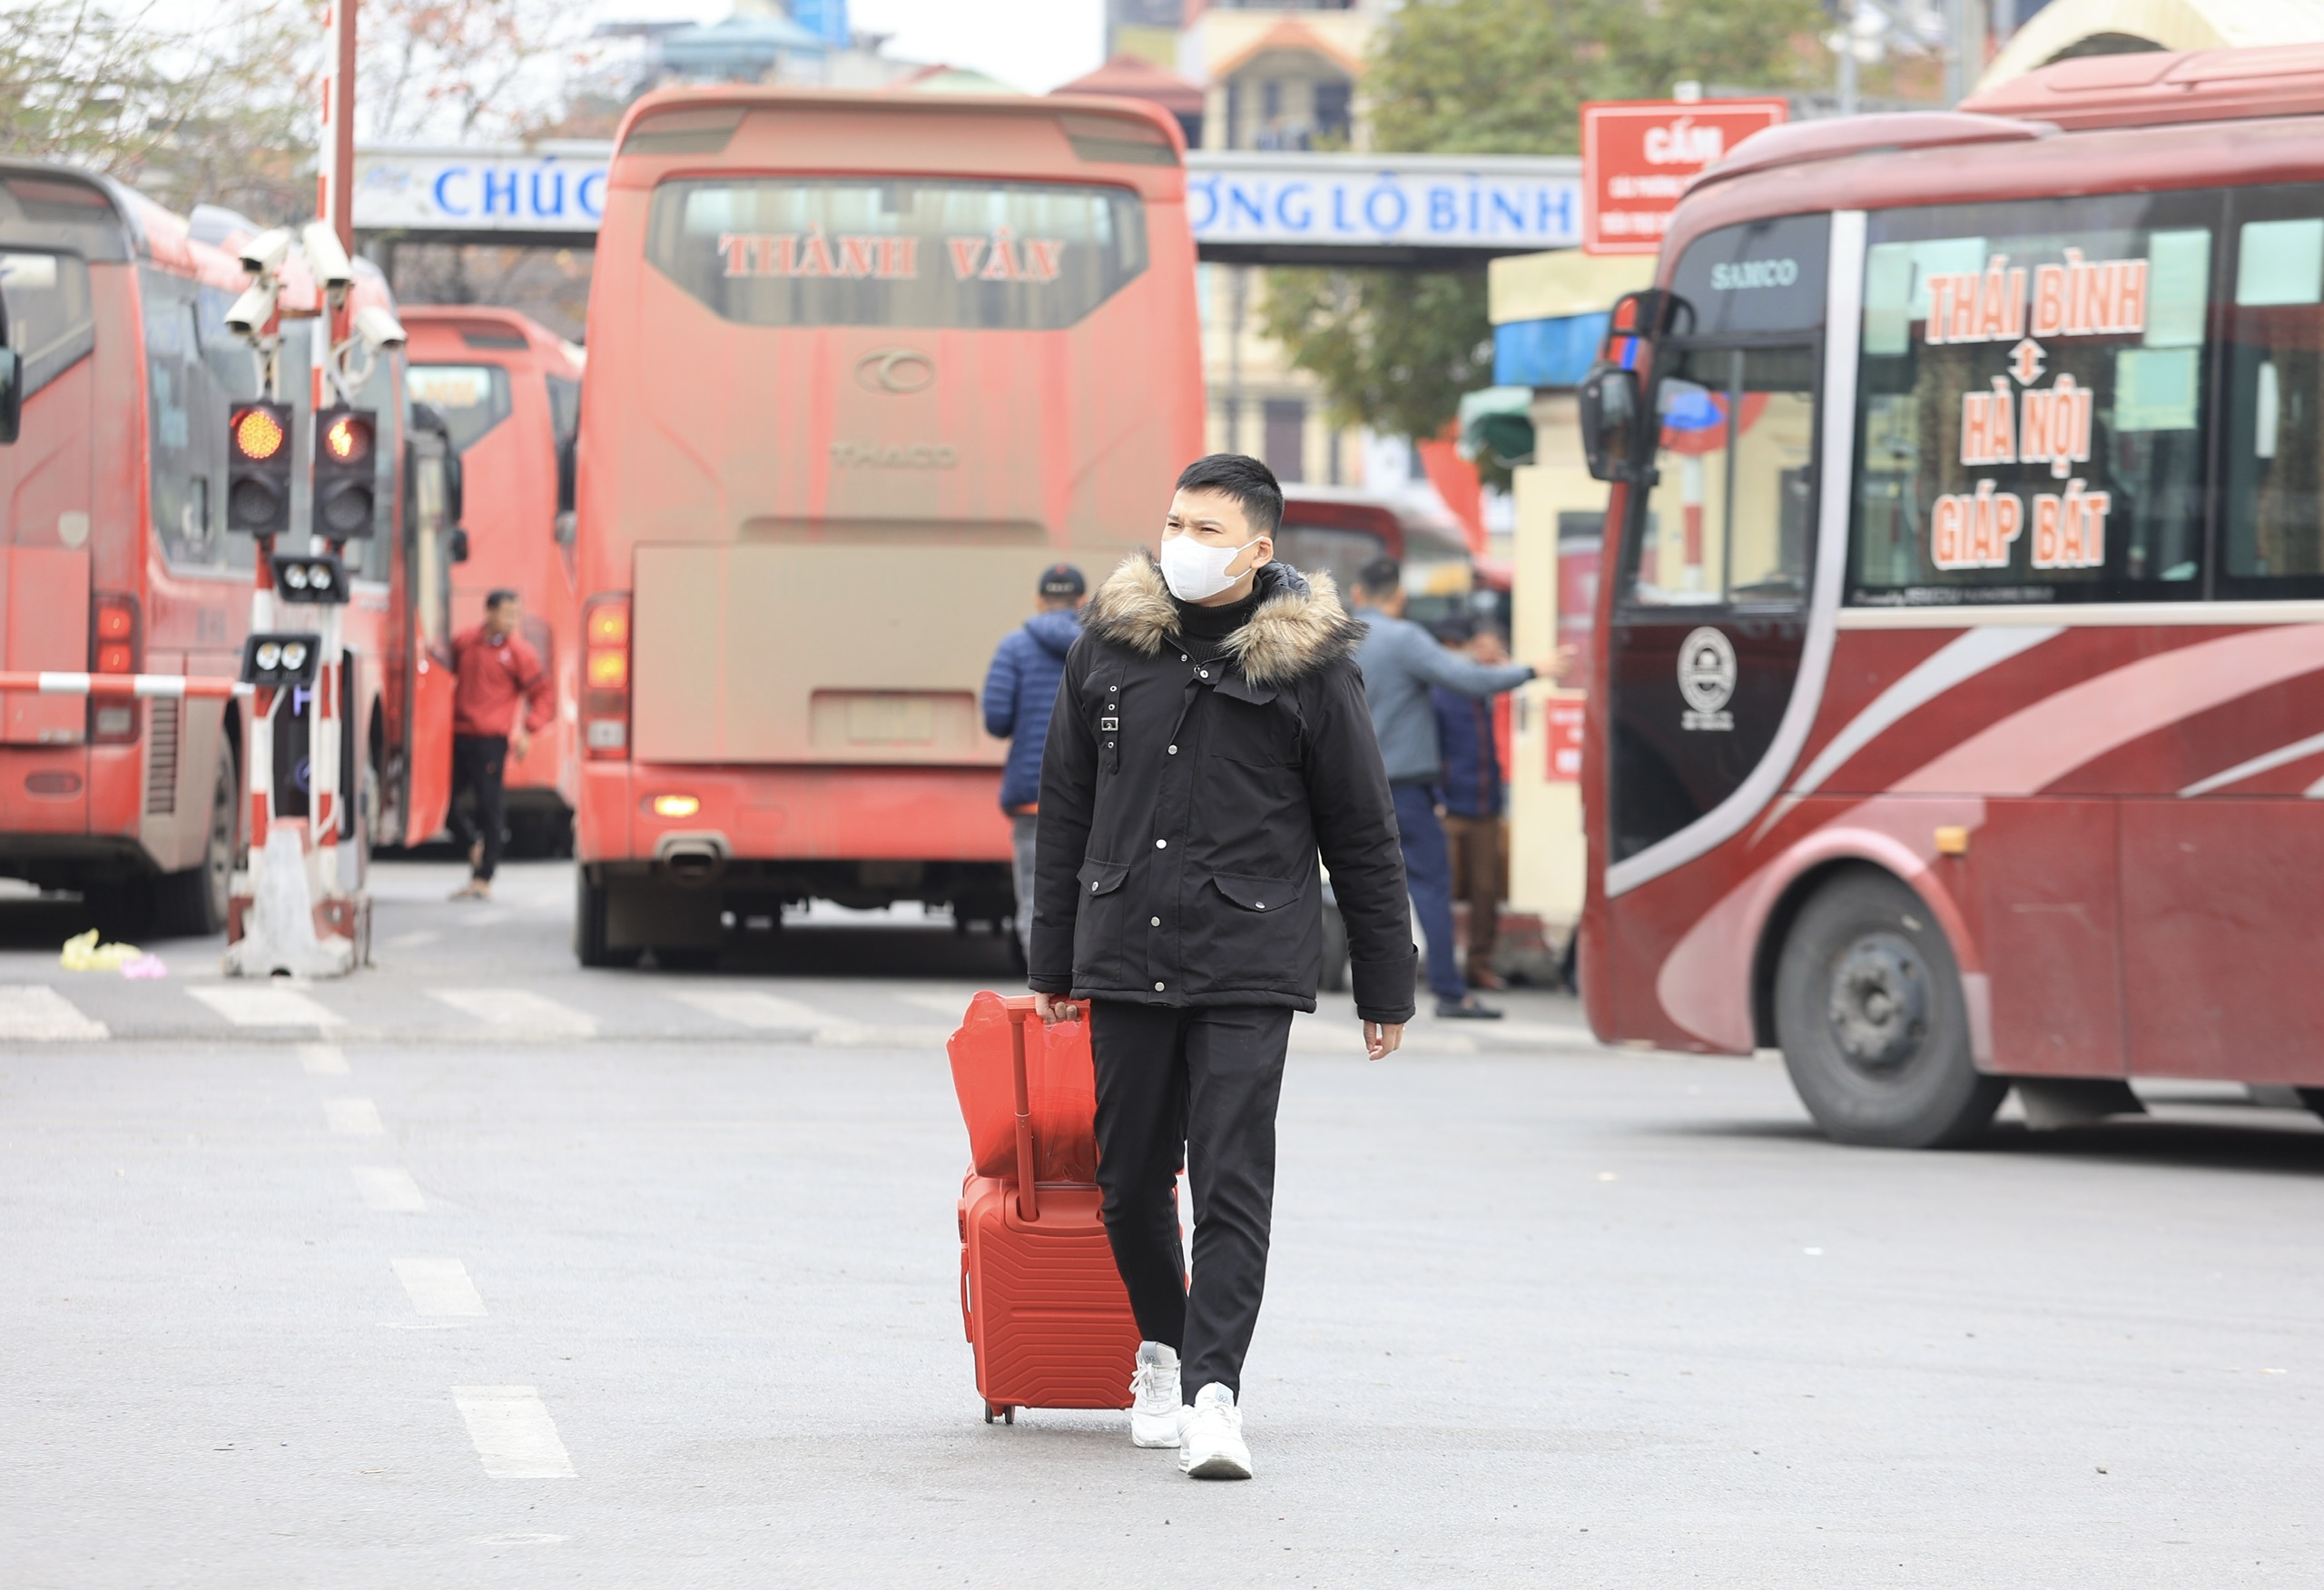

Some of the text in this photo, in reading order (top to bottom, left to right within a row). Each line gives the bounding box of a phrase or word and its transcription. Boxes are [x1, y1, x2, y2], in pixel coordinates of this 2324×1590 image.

[436, 154, 608, 219] CHÚC
[1333, 171, 1407, 244] LỘ
[1429, 173, 1571, 233] BÌNH
[717, 221, 919, 280] THÀNH
[1925, 247, 2149, 345] THÁI BÌNH
[1960, 373, 2093, 479] HÀ NỘI
[1931, 478, 2112, 570] GIÁP BÁT
[1218, 1395, 1228, 1403] 92
